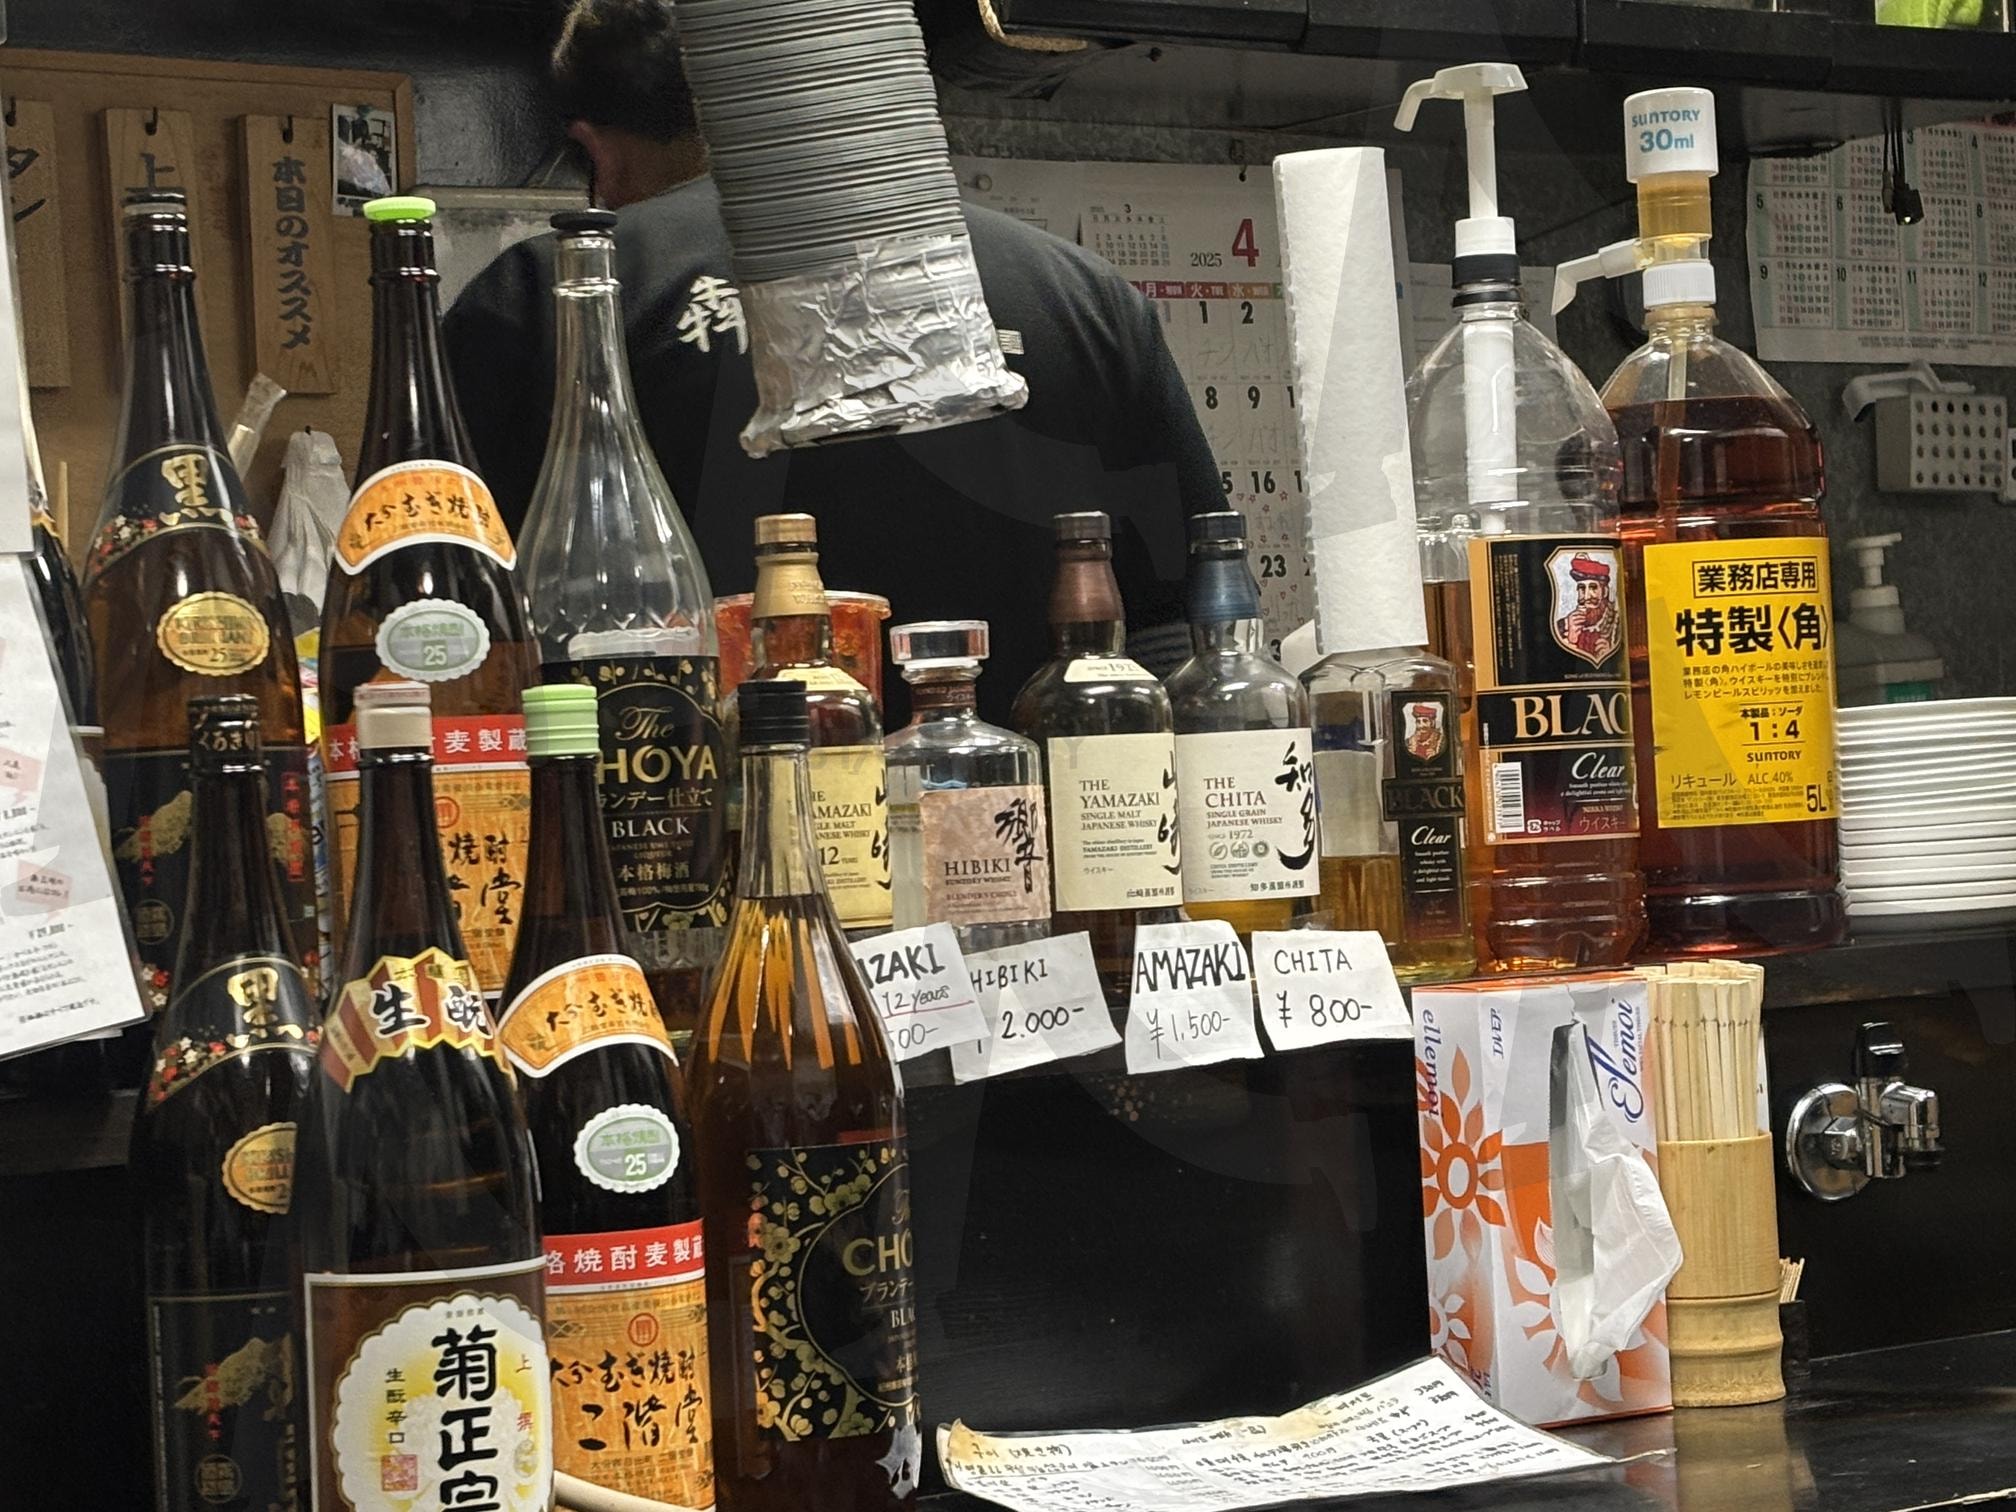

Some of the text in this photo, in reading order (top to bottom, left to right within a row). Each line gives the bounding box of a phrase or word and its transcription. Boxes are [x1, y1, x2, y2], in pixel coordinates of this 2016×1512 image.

[1639, 128, 1695, 153] 30ml
[273, 155, 312, 350] 本日のオススメ
[1231, 217, 1260, 267] 4
[1190, 251, 1223, 268] 2025
[1760, 264, 1768, 281] 9
[1836, 266, 1847, 282] 10
[1907, 270, 1917, 284] 11
[1978, 272, 1988, 288] 12
[1199, 300, 1254, 325] 1 2
[1205, 385, 1296, 410] 8 9 1
[1221, 471, 1233, 495] 5
[1250, 470, 1276, 494] 16
[1259, 554, 1287, 578] 23
[1697, 560, 1816, 593] 業務店専用
[1675, 602, 1829, 658] 特製〈角〉
[423, 645, 447, 667] 25
[614, 705, 675, 742] The
[599, 744, 718, 785] HOYA
[1571, 751, 1626, 780] Clear
[1079, 779, 1111, 792] THE
[1203, 776, 1236, 790] THE
[1671, 771, 1737, 790] リキュール
[1080, 791, 1161, 809] YAMAZAKI
[1205, 790, 1267, 809] CHITA
[1805, 783, 1827, 814] 5L
[812, 803, 872, 820] MAZAKI
[1081, 809, 1142, 821] SINGLE MALT
[1206, 808, 1266, 819] SINGLE GRAIN
[611, 817, 691, 839] BLACK
[1081, 819, 1158, 831] JAPANESE WHISKY
[1207, 817, 1283, 829] JAPANESE WHISKY
[1579, 816, 1627, 833] ウイスキー
[1228, 829, 1254, 840] 1972
[1411, 825, 1452, 846] Clear
[819, 846, 840, 867] 12
[943, 857, 1011, 877] HIBIKI
[1274, 949, 1353, 976] CHITA
[970, 958, 1049, 993] HIBIKI
[1422, 1008, 1442, 1116] ellemoi
[624, 1152, 647, 1176] 25
